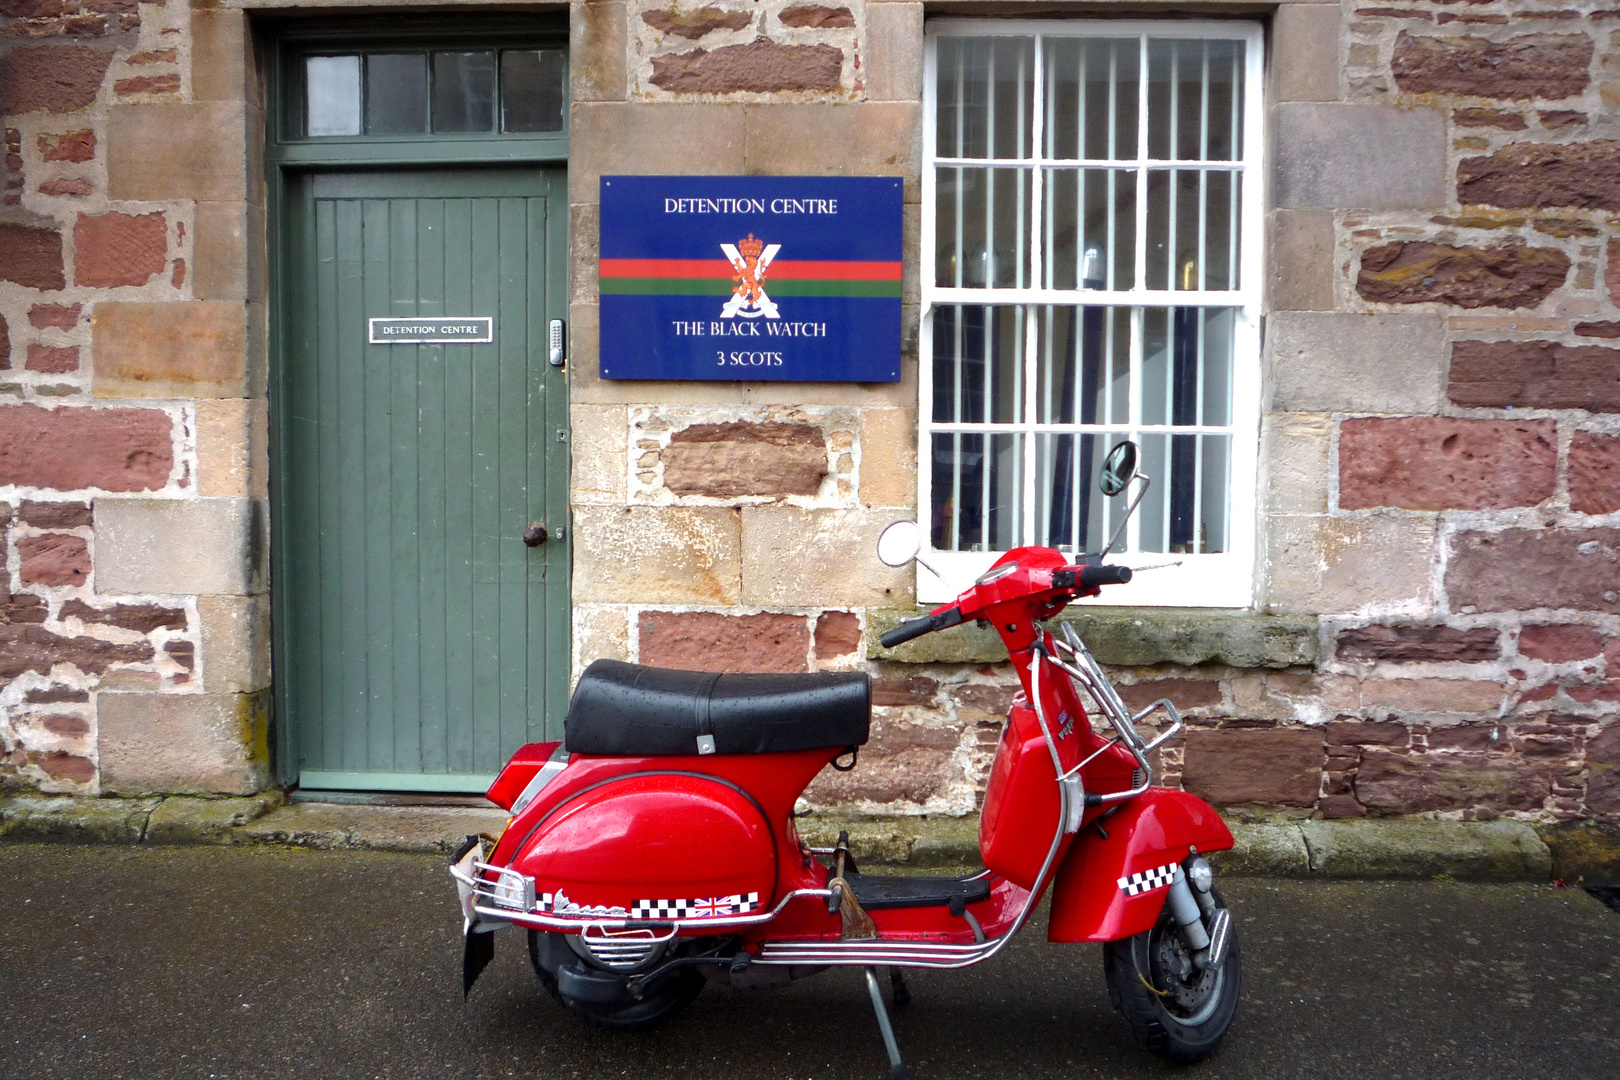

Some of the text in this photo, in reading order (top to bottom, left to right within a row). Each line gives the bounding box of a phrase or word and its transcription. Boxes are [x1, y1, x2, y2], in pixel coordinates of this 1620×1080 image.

[664, 198, 838, 214] DETENTION CENTRE
[382, 325, 479, 335] DETENTION CENTRE
[672, 321, 827, 337] THE BLACK WATCH
[716, 351, 783, 367] 3 SCOTS
